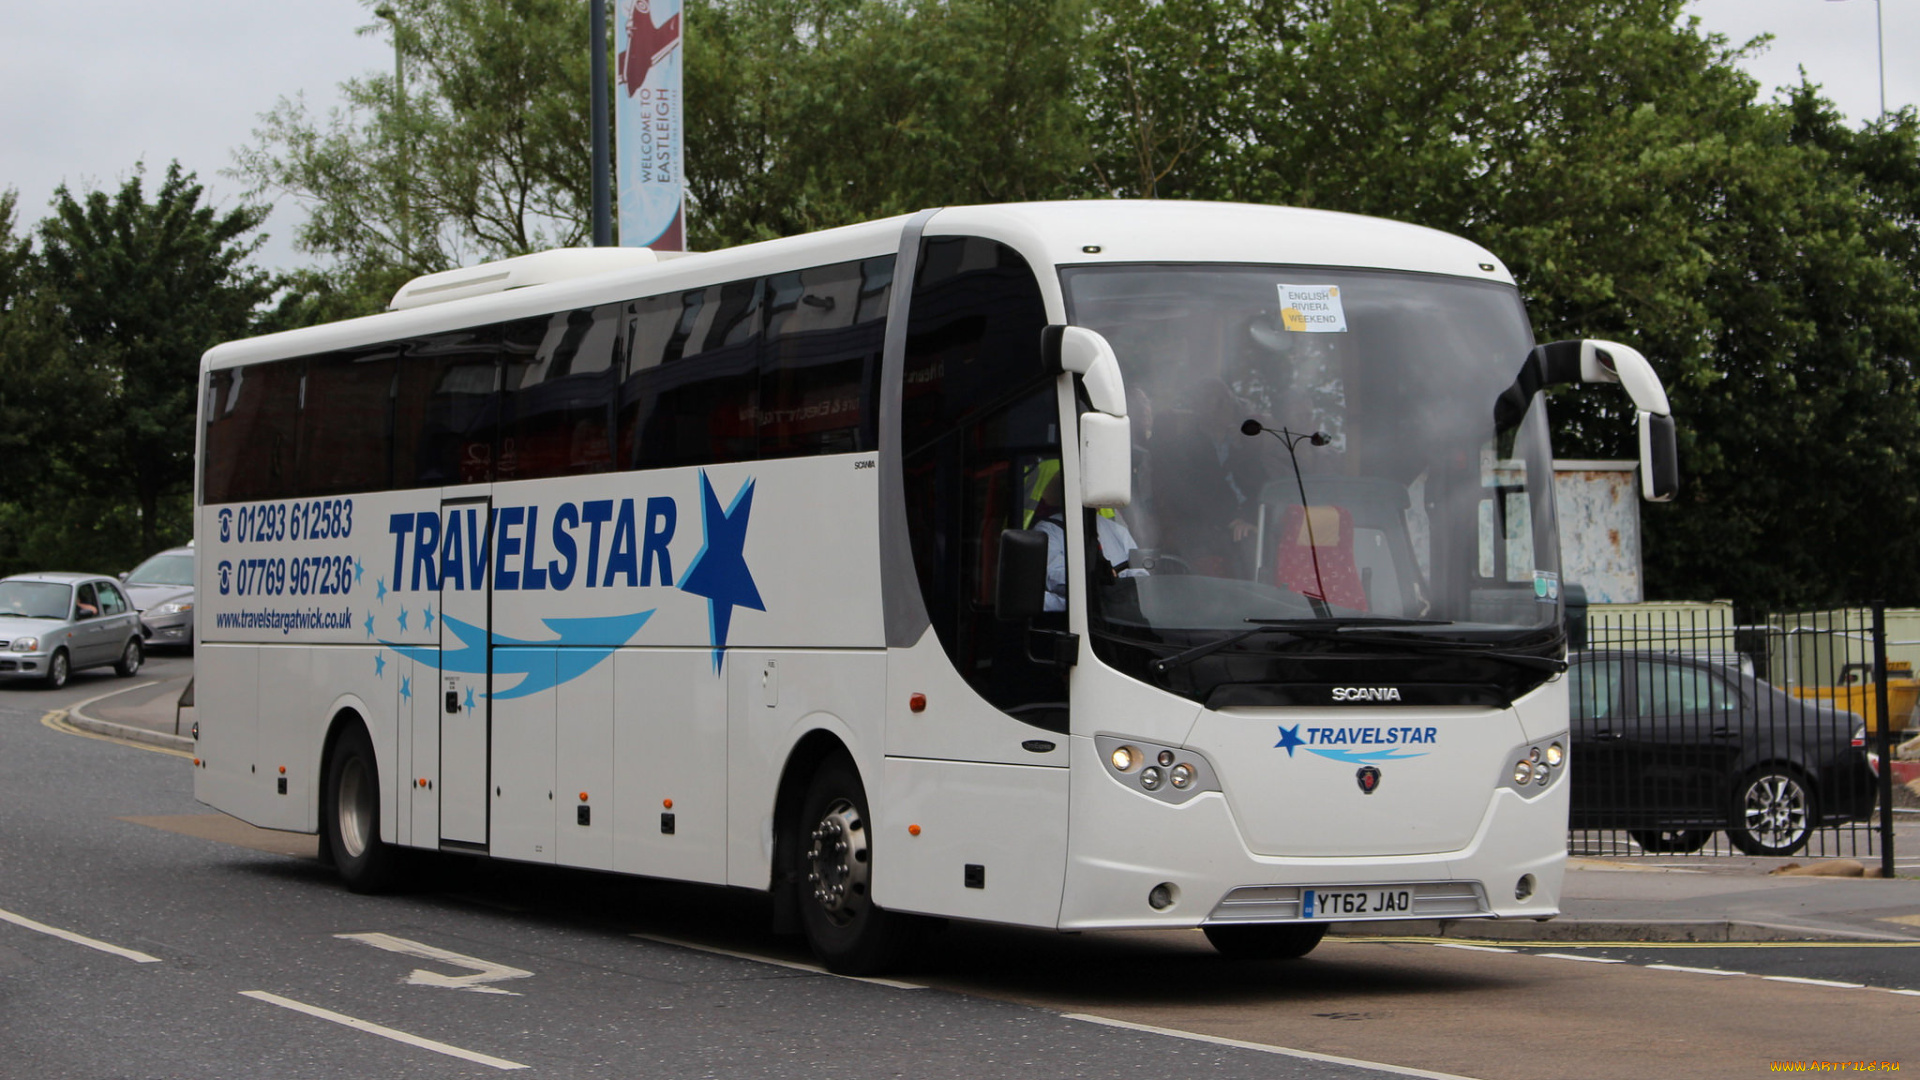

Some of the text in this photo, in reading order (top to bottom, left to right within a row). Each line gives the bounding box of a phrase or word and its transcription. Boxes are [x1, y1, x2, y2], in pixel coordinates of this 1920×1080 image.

[640, 88, 652, 183] WELCOME TO
[656, 88, 670, 183] EASTLEIGH
[1288, 291, 1329, 300] ENGLISH
[1291, 302, 1329, 311] RIVIERA
[1288, 315, 1336, 323] WEEKEND
[855, 460, 876, 470] SCANIA
[237, 499, 353, 544] 01293 612583
[389, 496, 678, 592] TRAVELSTAR
[237, 555, 353, 596] 07769 967236
[216, 606, 352, 635] www.travelstargatwick.co.uk
[1332, 687, 1402, 701] SCANIA
[1306, 727, 1438, 744] TRAVELSTAR
[1318, 891, 1409, 914] YT62 JAO
